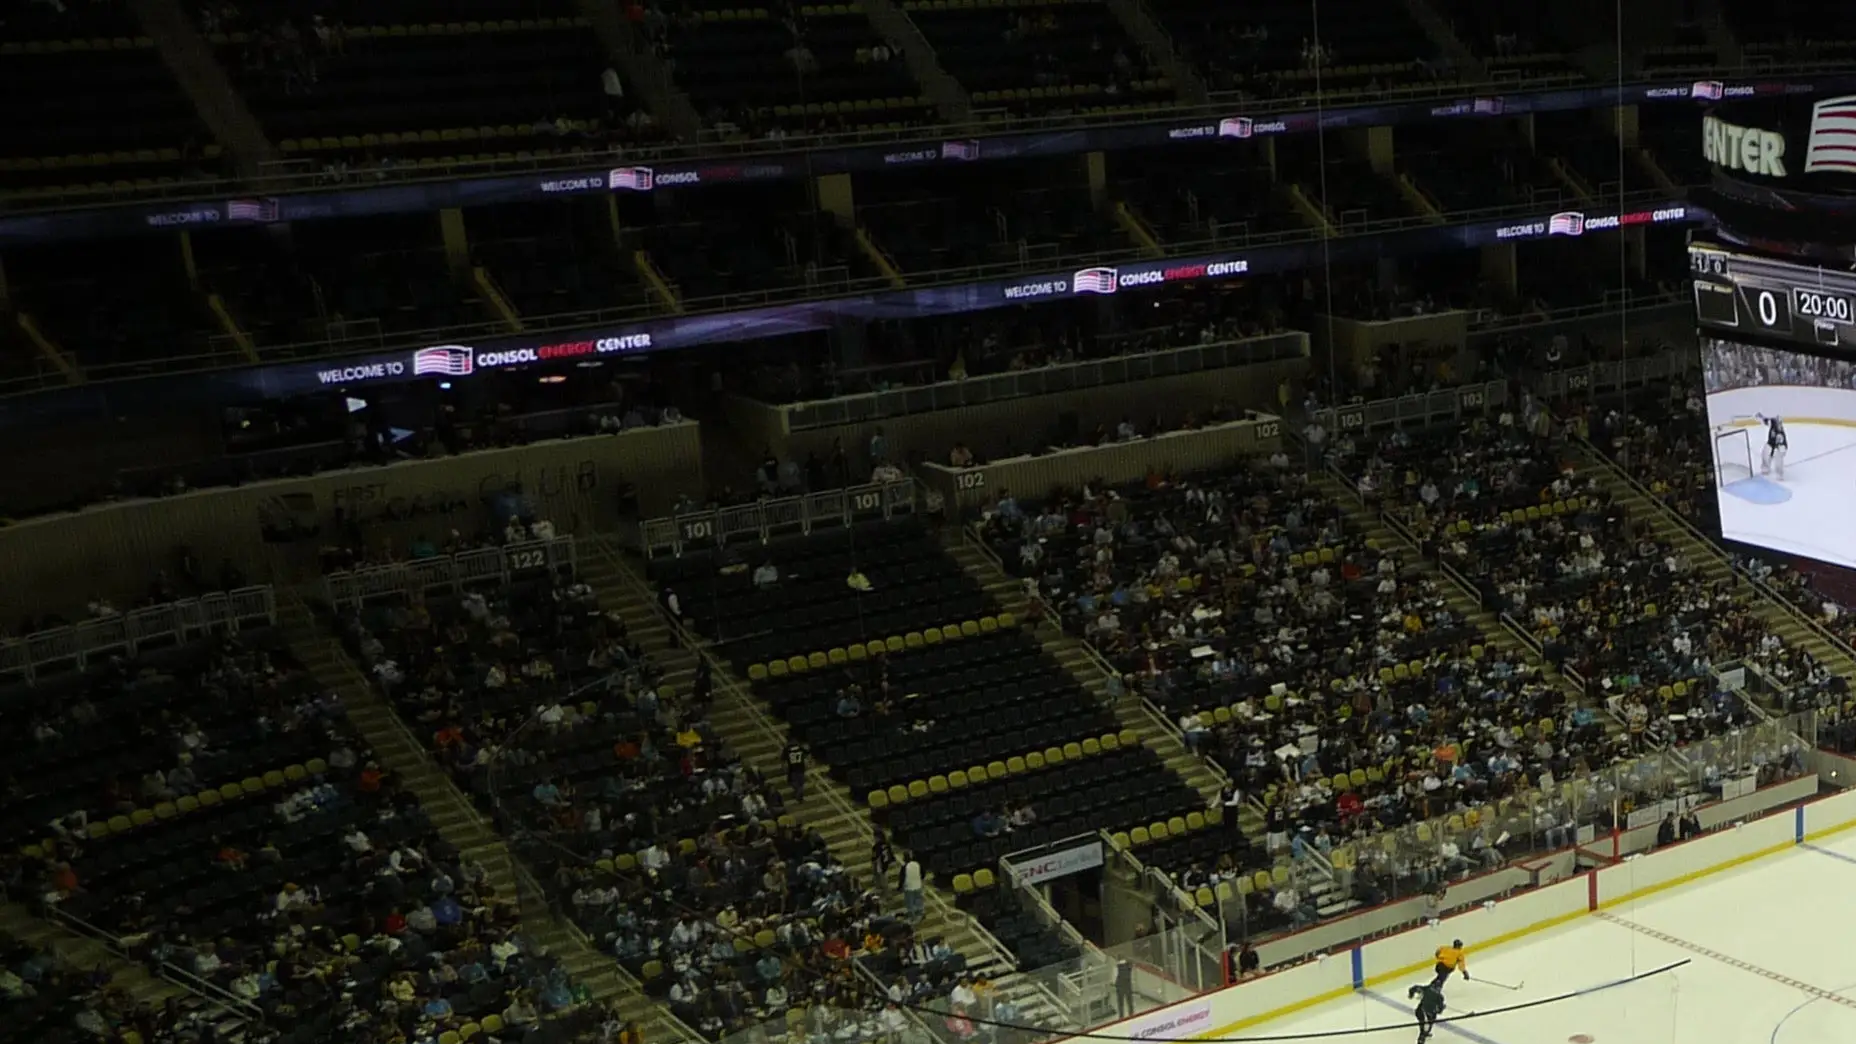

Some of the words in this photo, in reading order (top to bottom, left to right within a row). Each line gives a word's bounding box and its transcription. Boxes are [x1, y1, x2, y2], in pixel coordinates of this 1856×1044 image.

[541, 178, 588, 192] WELCOME
[588, 177, 603, 189] TO
[656, 170, 700, 185] CONSOL
[1496, 225, 1533, 239] WELCOME
[1533, 222, 1545, 234] TO
[1584, 215, 1620, 230] CONSOL
[1652, 207, 1685, 222] CENTER
[1003, 282, 1053, 299] WELCOME
[1052, 280, 1067, 292] TO
[1119, 269, 1165, 287] CONSOL
[1206, 259, 1248, 275] CENTER
[1759, 291, 1777, 326] 0
[1800, 293, 1848, 320] 20:00
[317, 364, 387, 384] WELCOME
[385, 361, 404, 376] TO
[477, 346, 538, 368] CONSOL
[538, 340, 597, 360] ENERGY
[596, 333, 652, 352] CENTER
[1568, 373, 1589, 389] 104
[1462, 391, 1483, 407] 103
[1341, 411, 1363, 427] 103
[1255, 423, 1280, 438] 102
[956, 472, 985, 490] 102
[854, 492, 882, 511] 101
[685, 520, 713, 539] 101
[511, 550, 545, 570] 122
[1141, 1021, 1176, 1038] CONSOL
